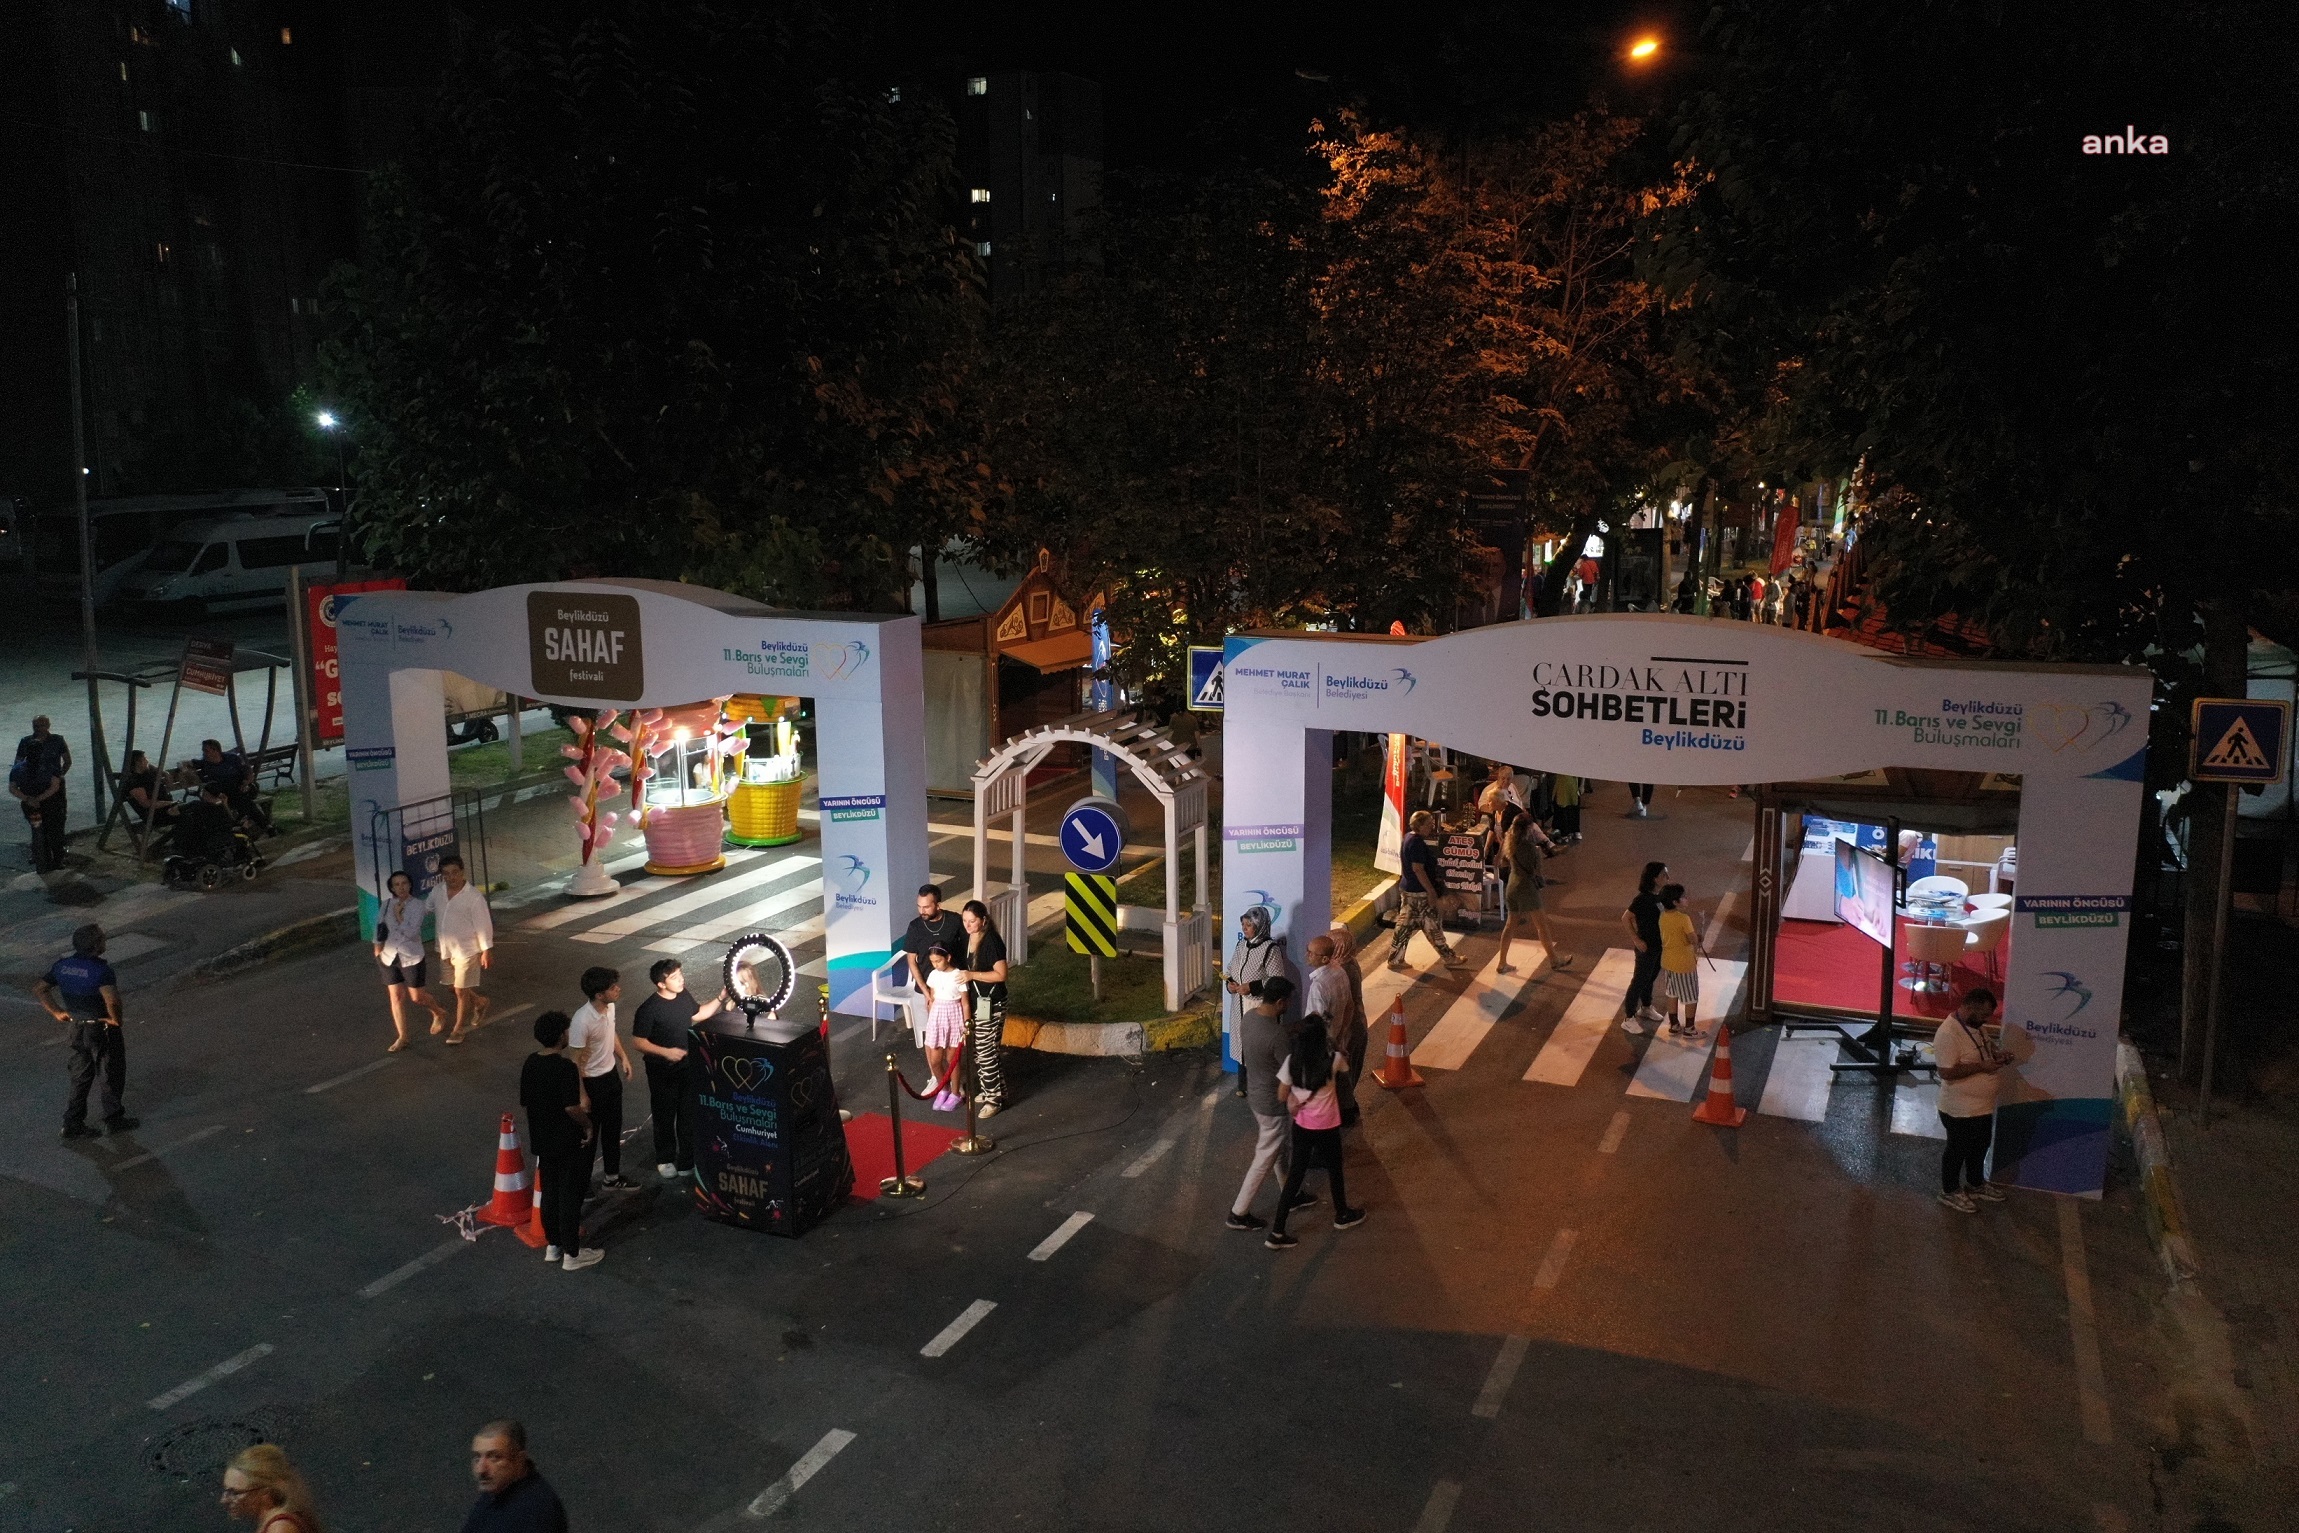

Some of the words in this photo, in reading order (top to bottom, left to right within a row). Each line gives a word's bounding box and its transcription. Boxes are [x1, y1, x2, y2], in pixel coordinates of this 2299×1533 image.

[557, 609, 609, 623] Beylikdüzü
[544, 627, 625, 665] SAHAF
[761, 640, 808, 652] Beylikdüzü
[765, 654, 777, 664] ve
[780, 652, 809, 668] Sevgi
[569, 669, 604, 682] festivali
[747, 662, 809, 678] Buluşmaları
[1235, 667, 1274, 678] MEHMET
[1276, 671, 1311, 680] MURAT
[1281, 679, 1311, 690] ÇALIK
[1326, 675, 1388, 692] Beylikdüzü
[1532, 661, 1665, 692] ÇARDAK
[1674, 669, 1750, 697] ALTI
[1325, 688, 1368, 701] Belediyesi
[1942, 699, 2023, 715] Beylikdüzü
[1945, 718, 1967, 729] ve
[1972, 715, 2021, 736] Sevgi
[1641, 728, 1745, 751] Beylikdüzü
[1913, 727, 2020, 749] Buluşmaları
[823, 799, 851, 807] YARININ
[851, 796, 881, 806] ÖNCÜSÜ
[833, 808, 876, 819] BEYLİKDÜZÜ
[1228, 828, 1261, 837] YARININ
[1263, 826, 1299, 835] ÖNCÜSÜ
[1240, 839, 1293, 850] BEYLİKDÜZÜ
[1448, 835, 1474, 847] ATEŞ
[1443, 845, 1480, 859] GÜMÜŞ
[835, 893, 877, 905] Beylikdüzü
[2024, 899, 2071, 908] YARININ
[2073, 897, 2125, 908] ÖNCÜSÜ
[2039, 912, 2114, 925] BEYLİKDÜZÜ
[2026, 1020, 2097, 1039] Beylikdüzü
[735, 1103, 748, 1114] ve
[750, 1103, 777, 1120] Sevgi
[719, 1108, 778, 1130] Buluşmaları
[735, 1123, 778, 1139] Cumhuriyet
[718, 1171, 769, 1199] SAHAF
